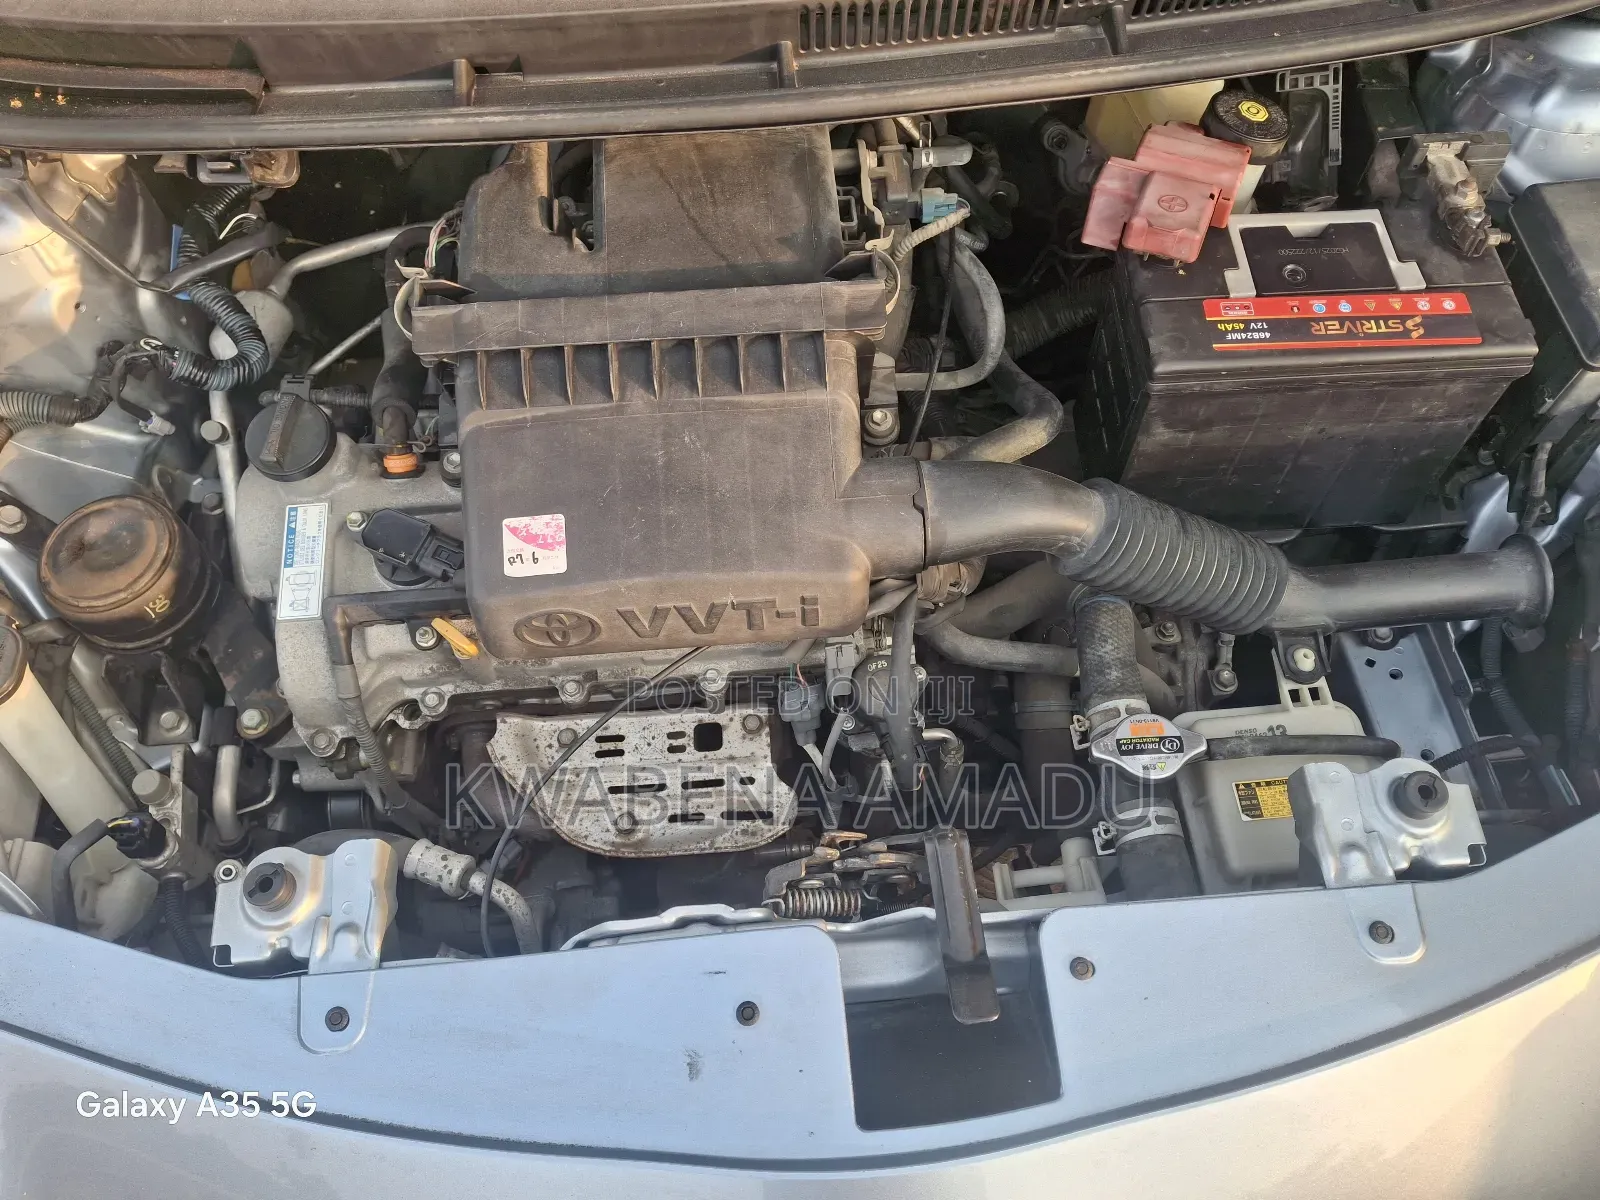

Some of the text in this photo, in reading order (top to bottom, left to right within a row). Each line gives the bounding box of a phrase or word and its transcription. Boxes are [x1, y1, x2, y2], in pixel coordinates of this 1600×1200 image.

[1217, 322, 1269, 331] 12V 45Ah
[1226, 332, 1271, 340] 46B24MF
[286, 534, 295, 565] NOTICE
[616, 594, 820, 638] VVT-i
